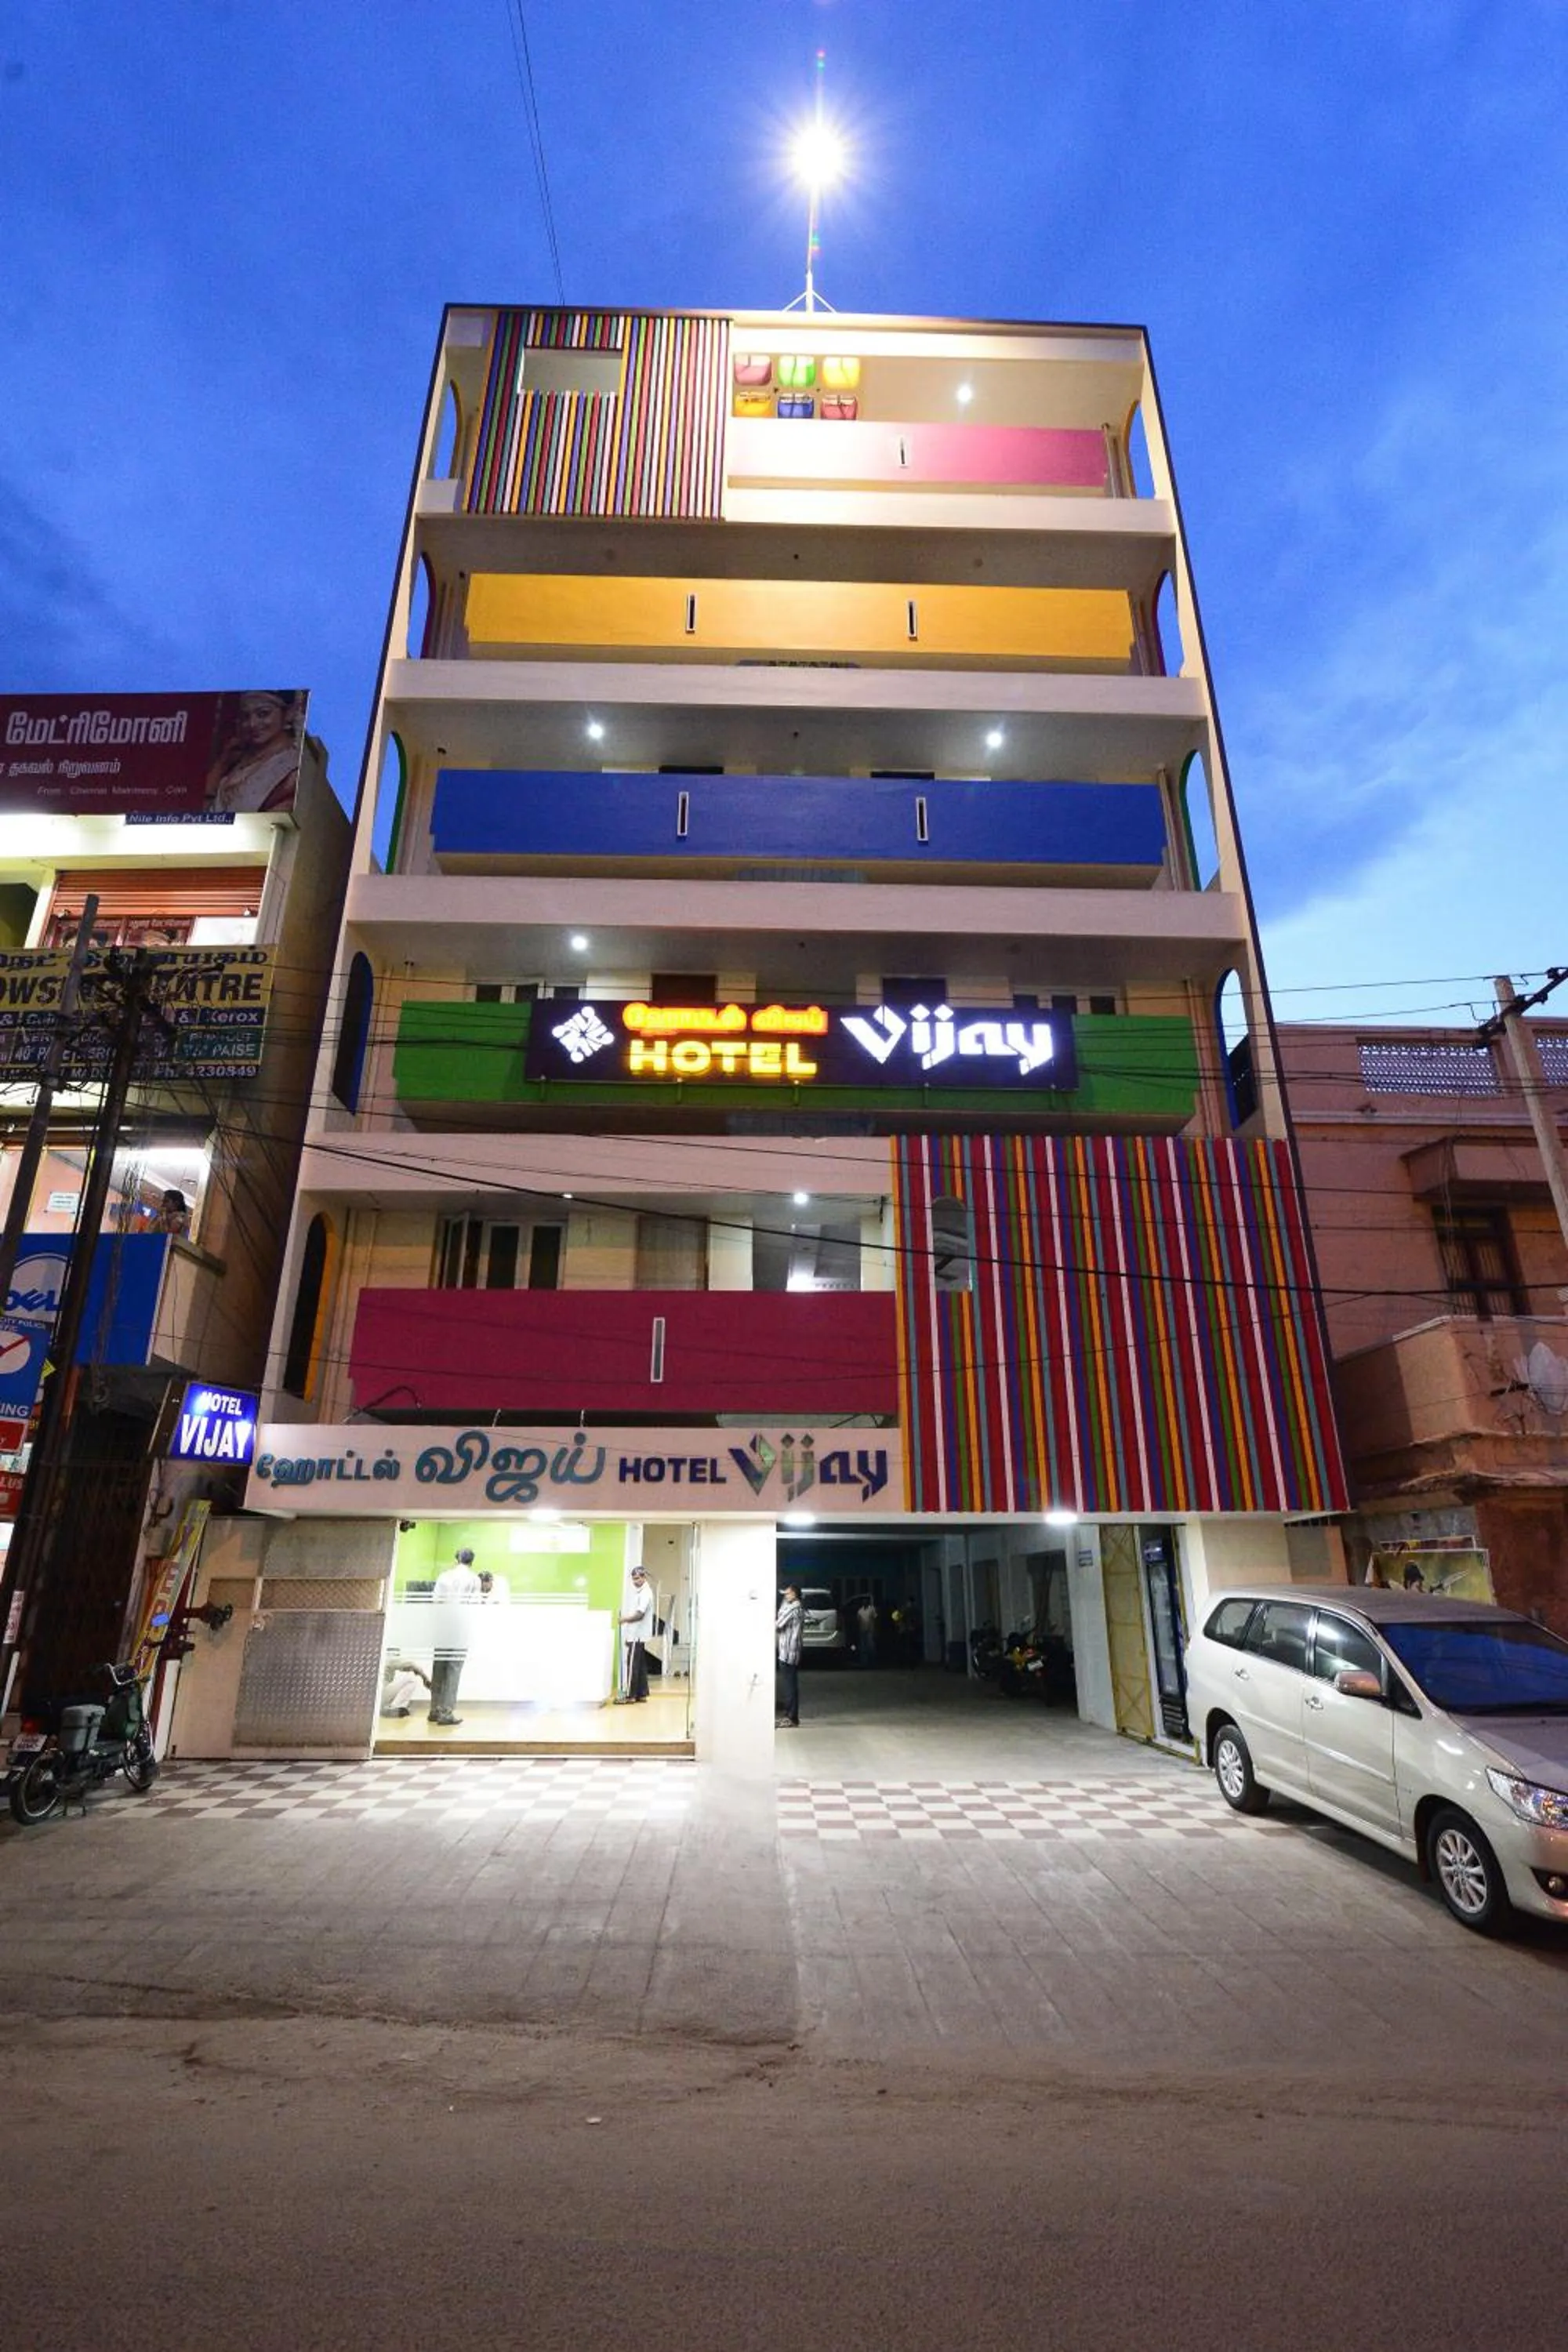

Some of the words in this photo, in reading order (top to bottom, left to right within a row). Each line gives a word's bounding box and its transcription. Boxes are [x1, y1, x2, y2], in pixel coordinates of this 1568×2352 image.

[5, 710, 188, 745] மேட்ரிமோனி
[630, 1040, 817, 1074] HOTEL
[840, 1004, 1054, 1075] Vijay
[198, 1391, 242, 1416] HOTEL
[180, 1414, 252, 1459] VIJAY
[256, 1450, 401, 1489] ஹோட்டல்
[415, 1430, 606, 1504] விஜய்
[619, 1457, 727, 1484] HOTEL
[728, 1432, 888, 1503] Vijay
